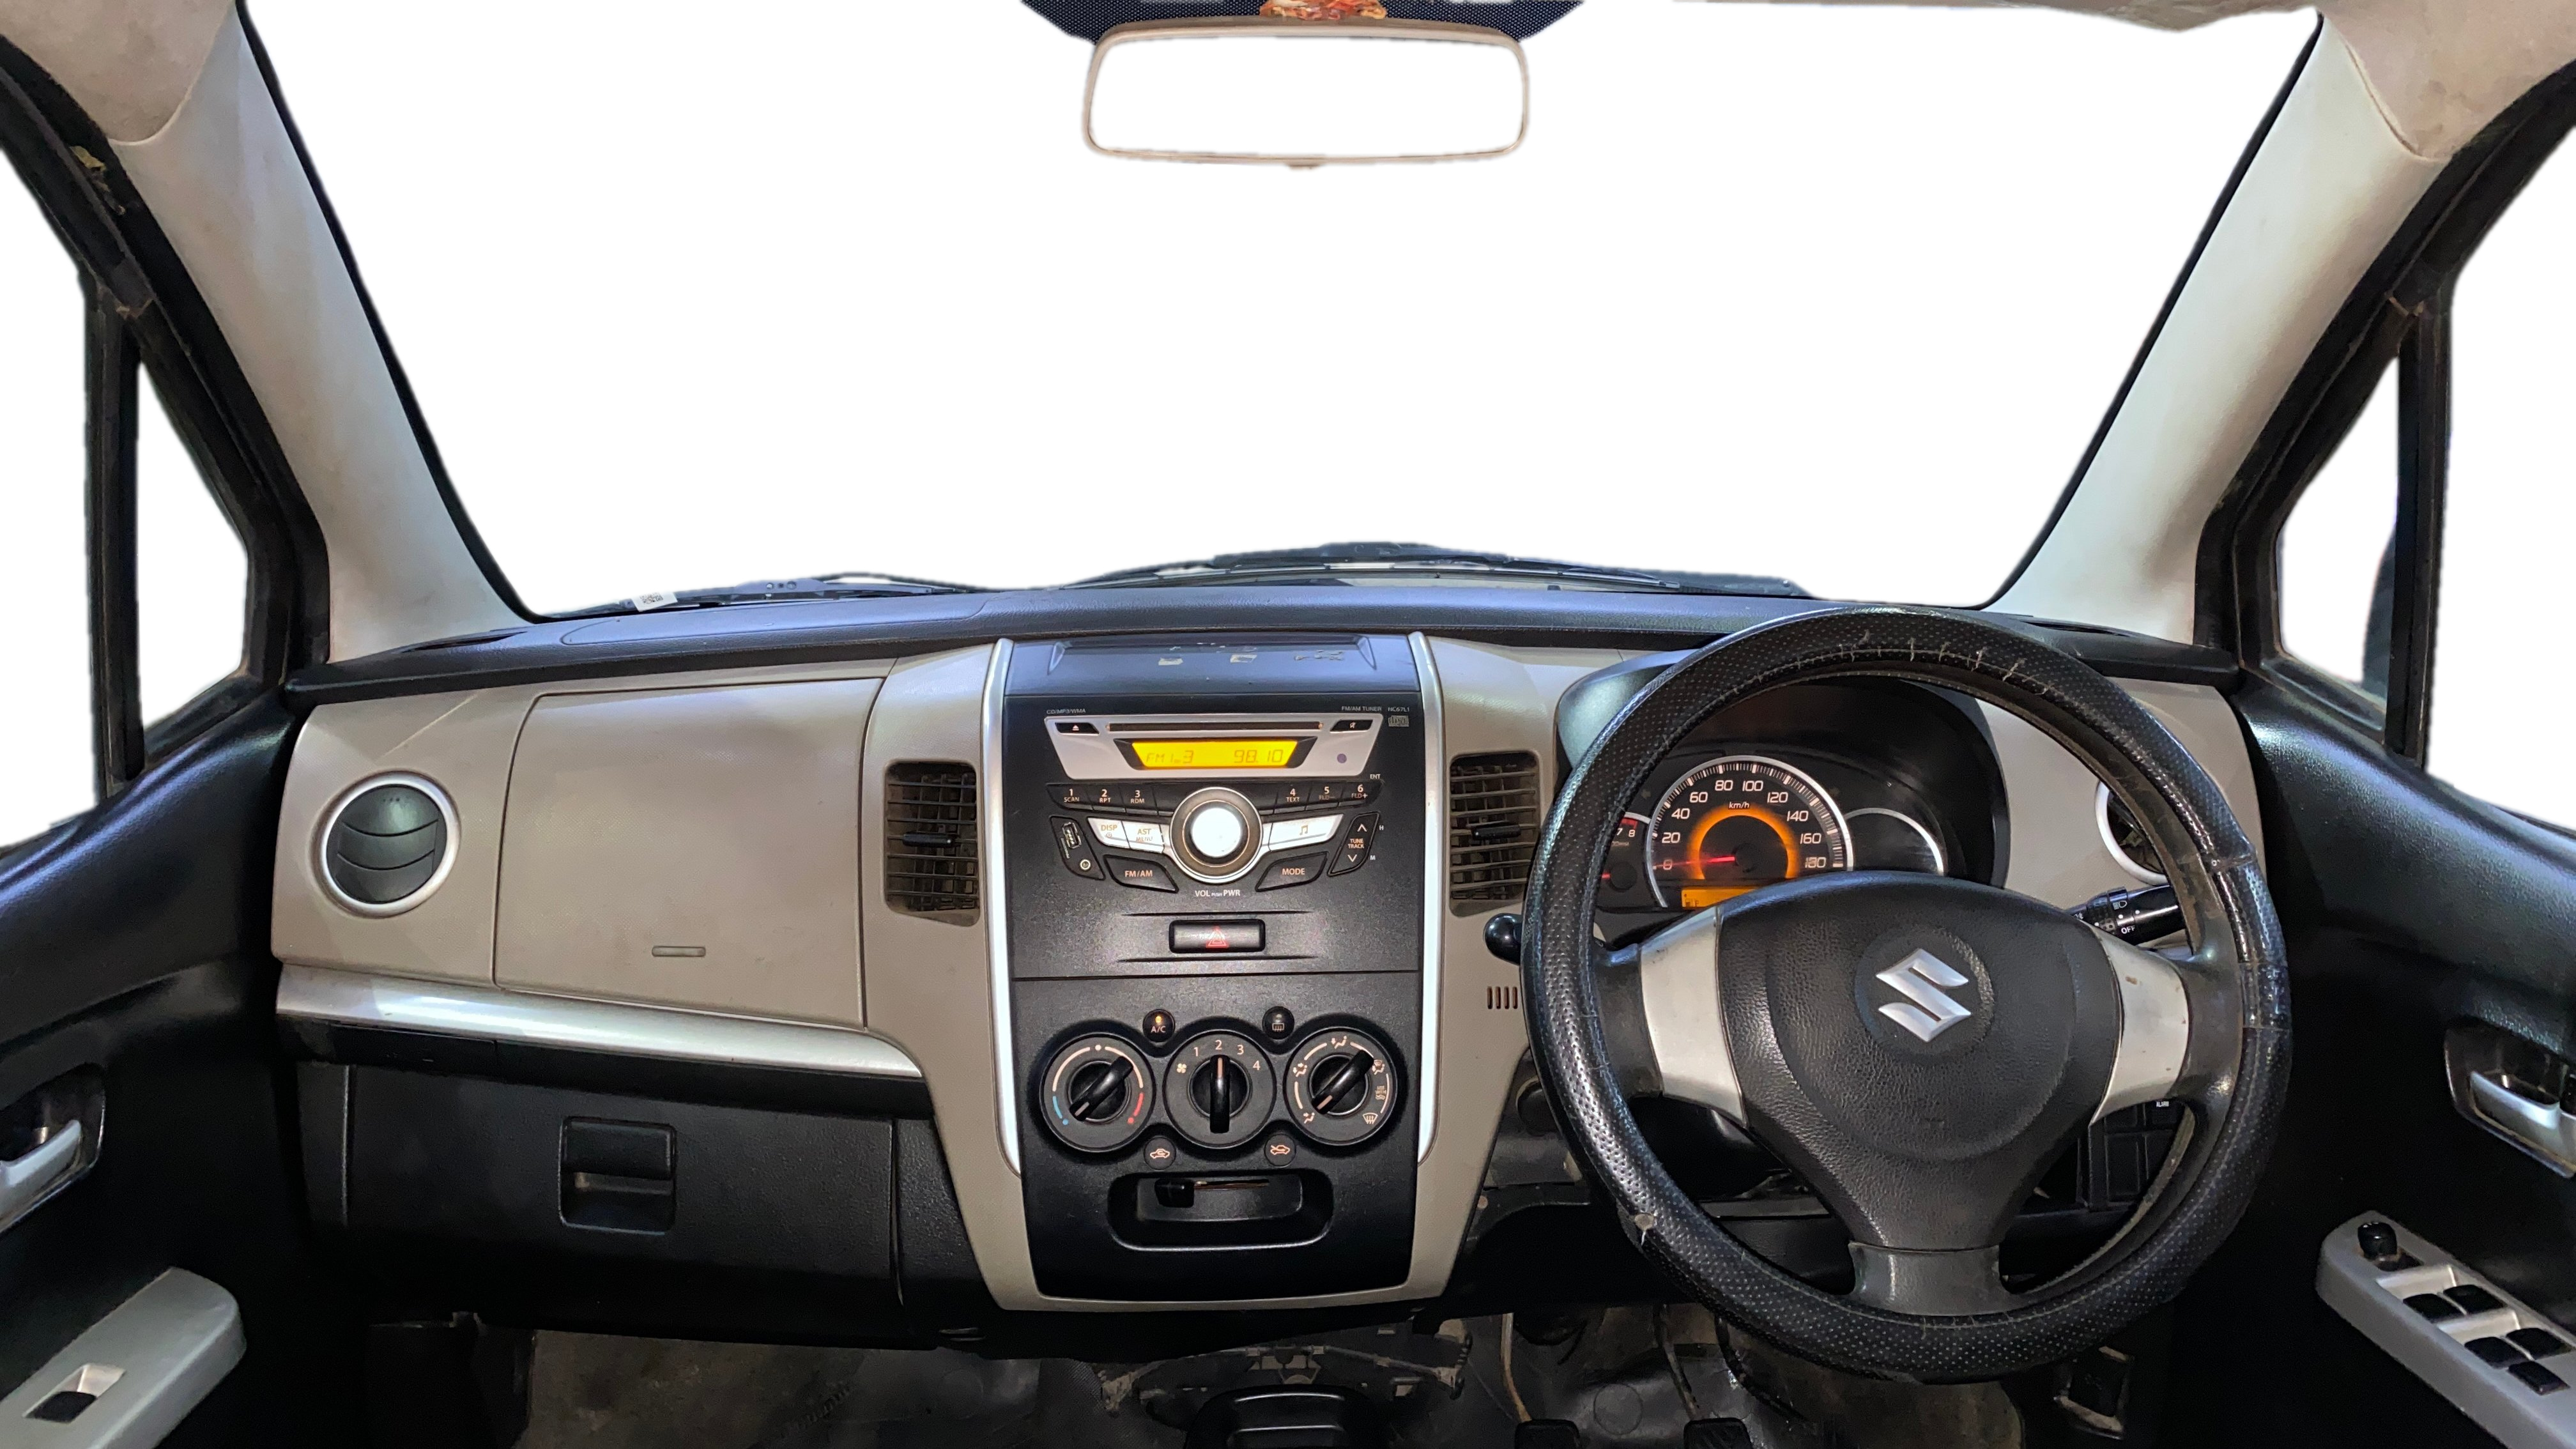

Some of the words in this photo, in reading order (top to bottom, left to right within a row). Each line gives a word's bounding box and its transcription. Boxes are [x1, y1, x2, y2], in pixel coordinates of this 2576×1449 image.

[1324, 786, 1330, 795] 5
[1357, 784, 1364, 792] 6
[1714, 779, 1733, 792] 80
[1742, 780, 1763, 792] 100
[1069, 788, 1073, 797] 1
[1101, 789, 1108, 797] 2
[1689, 792, 1708, 803] 60
[1767, 792, 1788, 803] 120
[1671, 808, 1690, 820] 40
[1786, 810, 1809, 822] 140
[1628, 829, 1636, 838] 8
[1662, 832, 1680, 843] 20
[1800, 832, 1821, 844] 160
[1805, 857, 1827, 868] 180
[1124, 870, 1153, 878] FM/AM
[2120, 925, 2135, 934] OFF
[1215, 1039, 1222, 1050] 2
[1237, 1045, 1245, 1055] 3
[1193, 1046, 1199, 1057] 1
[1252, 1060, 1261, 1070] 4
